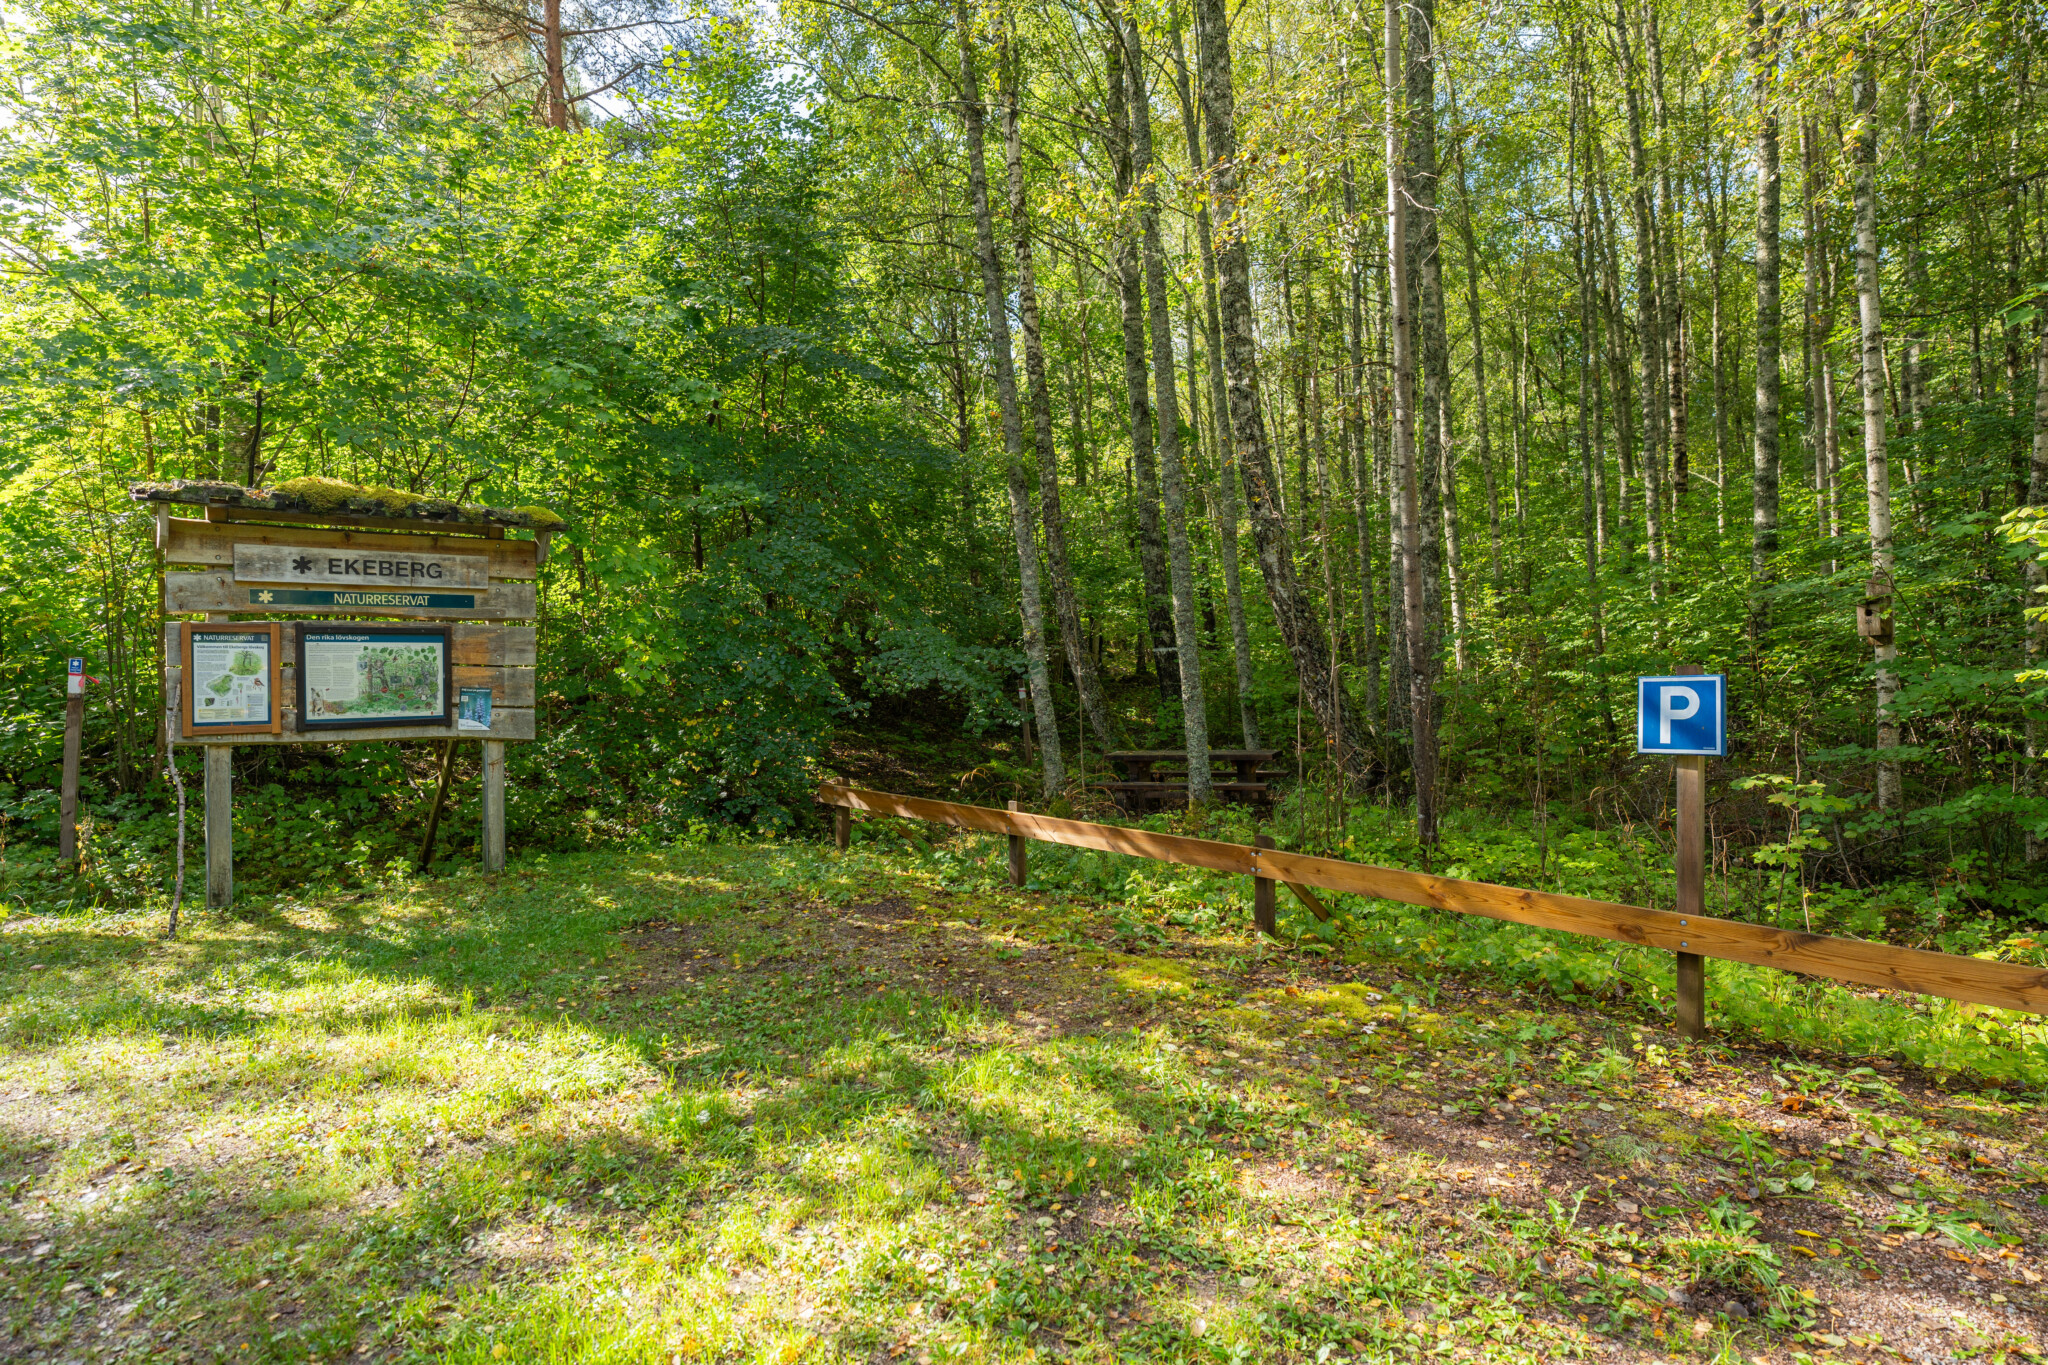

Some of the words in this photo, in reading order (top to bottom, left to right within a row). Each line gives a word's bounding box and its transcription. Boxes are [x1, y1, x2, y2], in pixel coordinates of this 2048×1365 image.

[328, 558, 443, 579] EKEBERG
[333, 592, 430, 607] NATURRESERVAT
[1659, 686, 1700, 744] P
